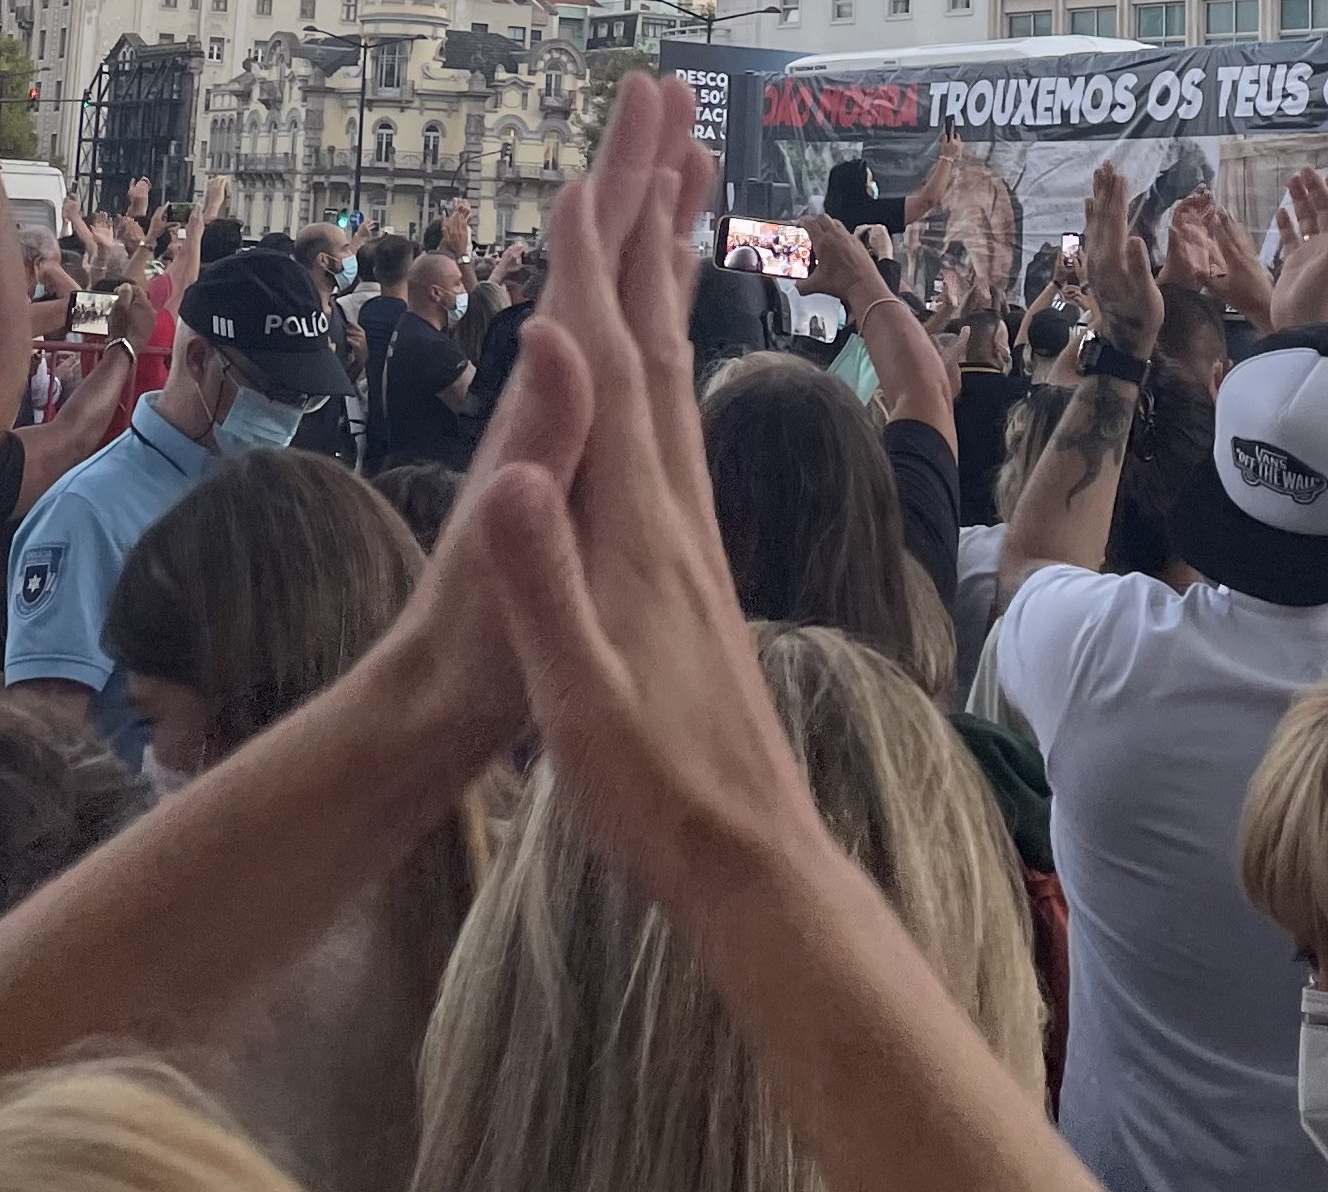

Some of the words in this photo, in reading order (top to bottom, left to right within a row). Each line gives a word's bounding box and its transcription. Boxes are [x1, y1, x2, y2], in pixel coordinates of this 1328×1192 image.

[929, 72, 1139, 128] TROUXEMOS
[1146, 66, 1207, 122] OS
[1216, 61, 1315, 119] TEUS
[1255, 445, 1288, 470] VANS
